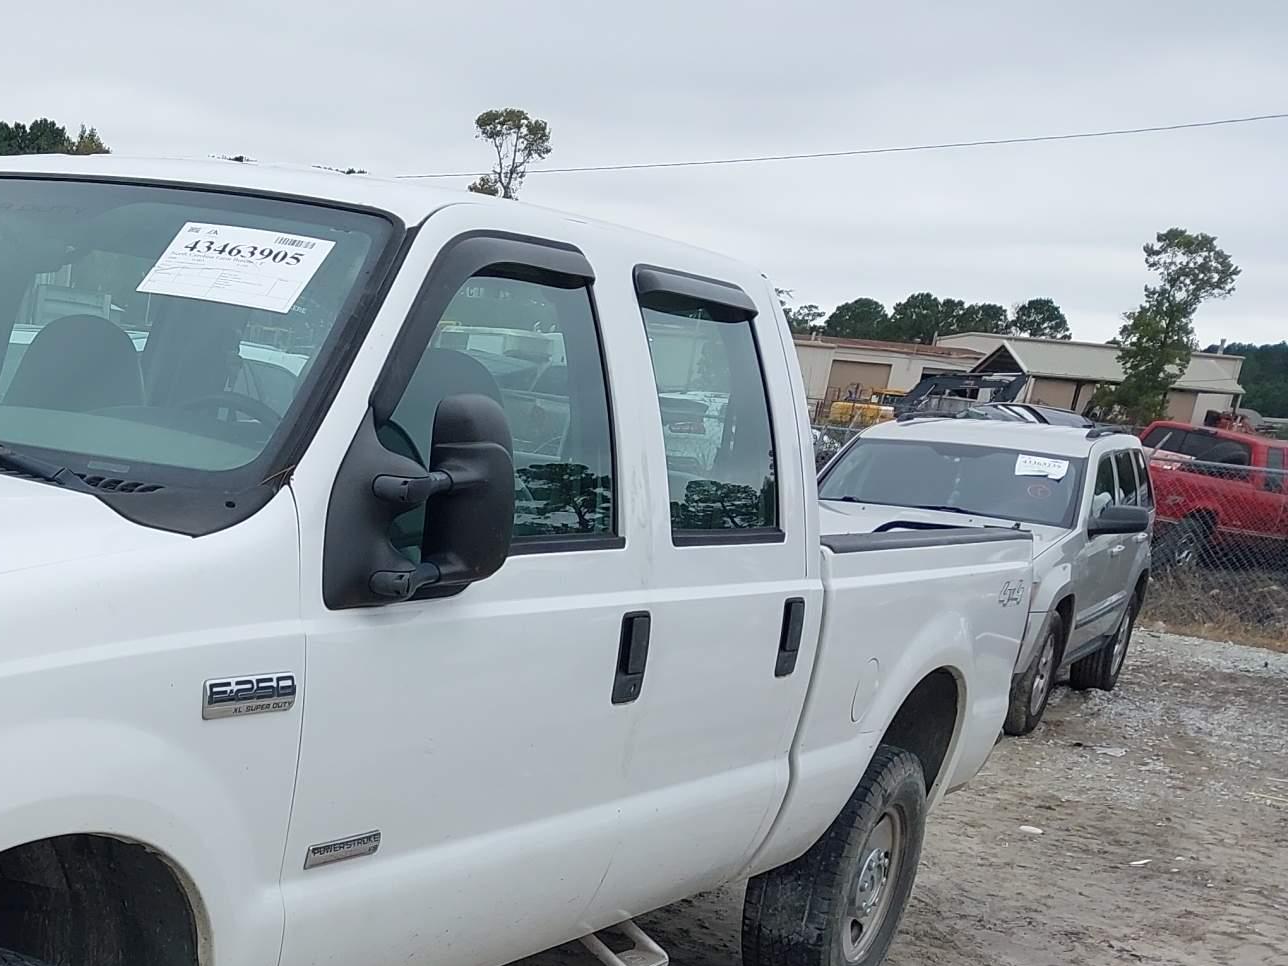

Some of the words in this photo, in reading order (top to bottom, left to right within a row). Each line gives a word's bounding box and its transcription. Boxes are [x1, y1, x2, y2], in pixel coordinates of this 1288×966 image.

[184, 239, 305, 266] 43463905
[208, 676, 297, 705] F-250
[232, 706, 243, 714] XL
[245, 703, 271, 713] SUPER
[272, 700, 294, 711] DUTY
